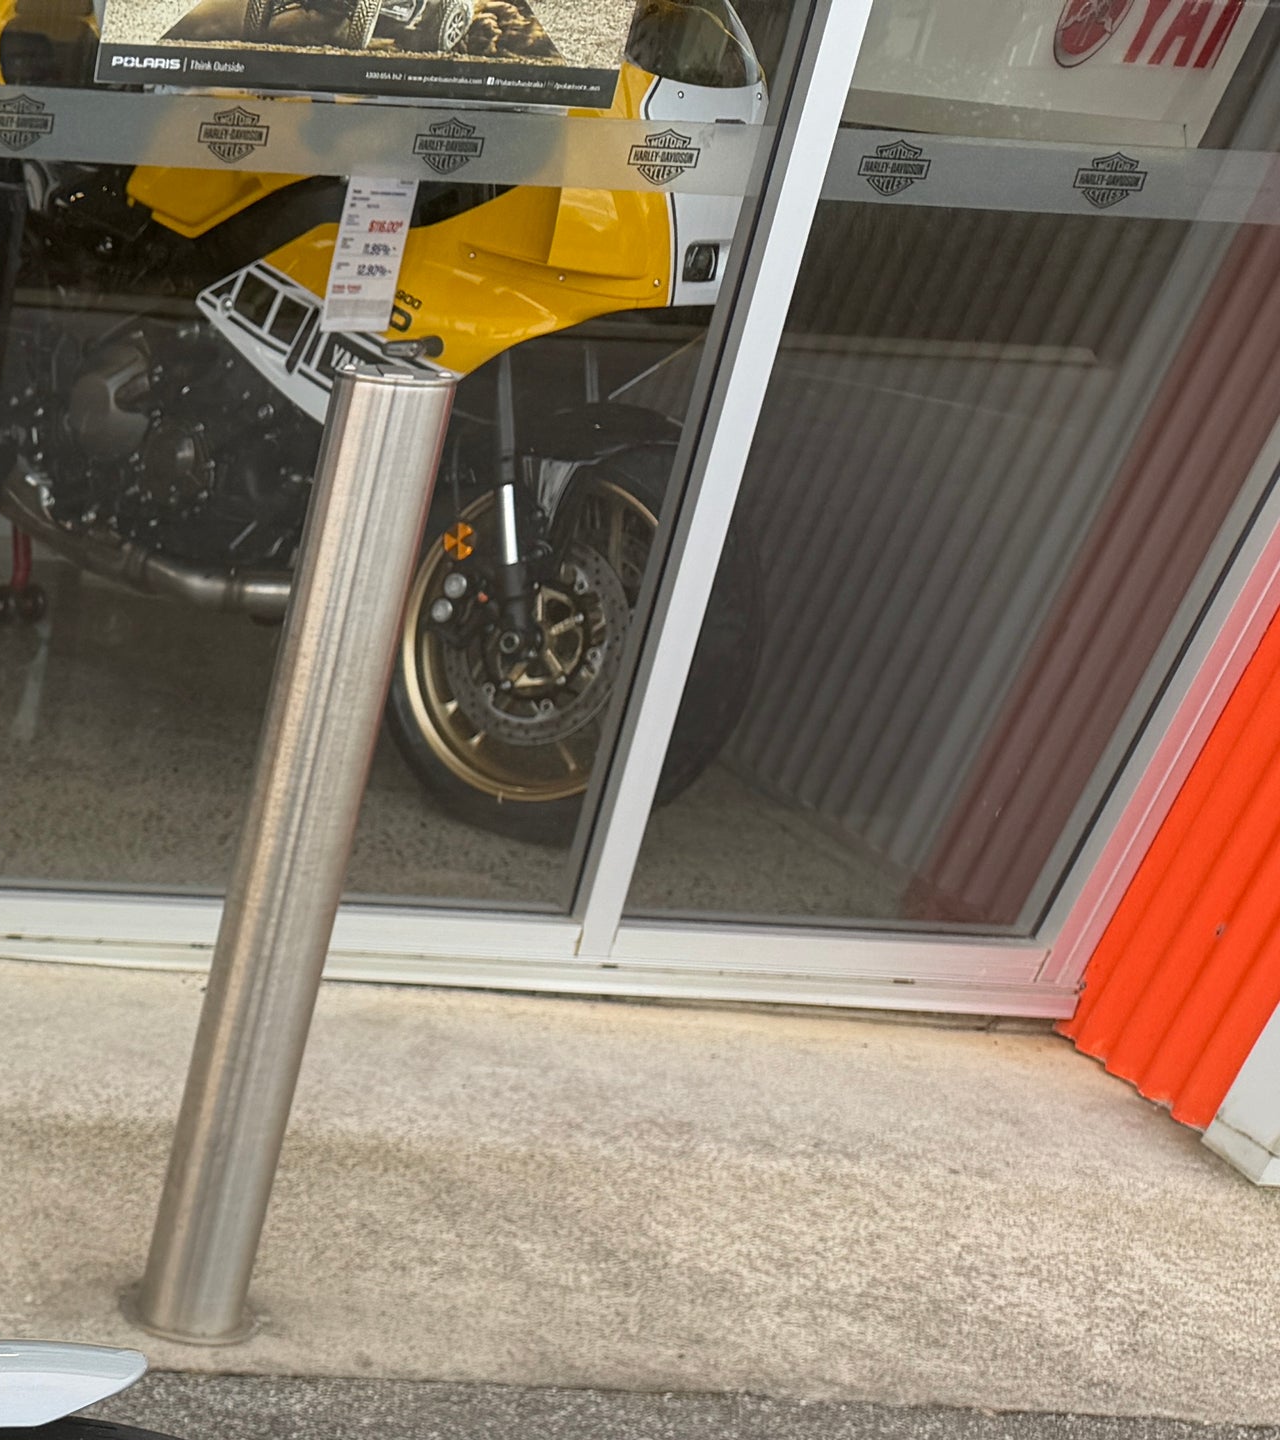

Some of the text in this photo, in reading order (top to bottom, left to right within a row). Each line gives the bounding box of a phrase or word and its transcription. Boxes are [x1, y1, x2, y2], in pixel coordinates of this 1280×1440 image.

[111, 55, 245, 73] POLARIS Think Outside
[648, 134, 686, 148] MOTOR
[632, 149, 694, 165] HARLEY-DAVIDSON
[879, 145, 917, 159] MOTOR
[640, 166, 681, 182] CYCLES
[862, 160, 925, 176] HARLEY-DAVIDSON
